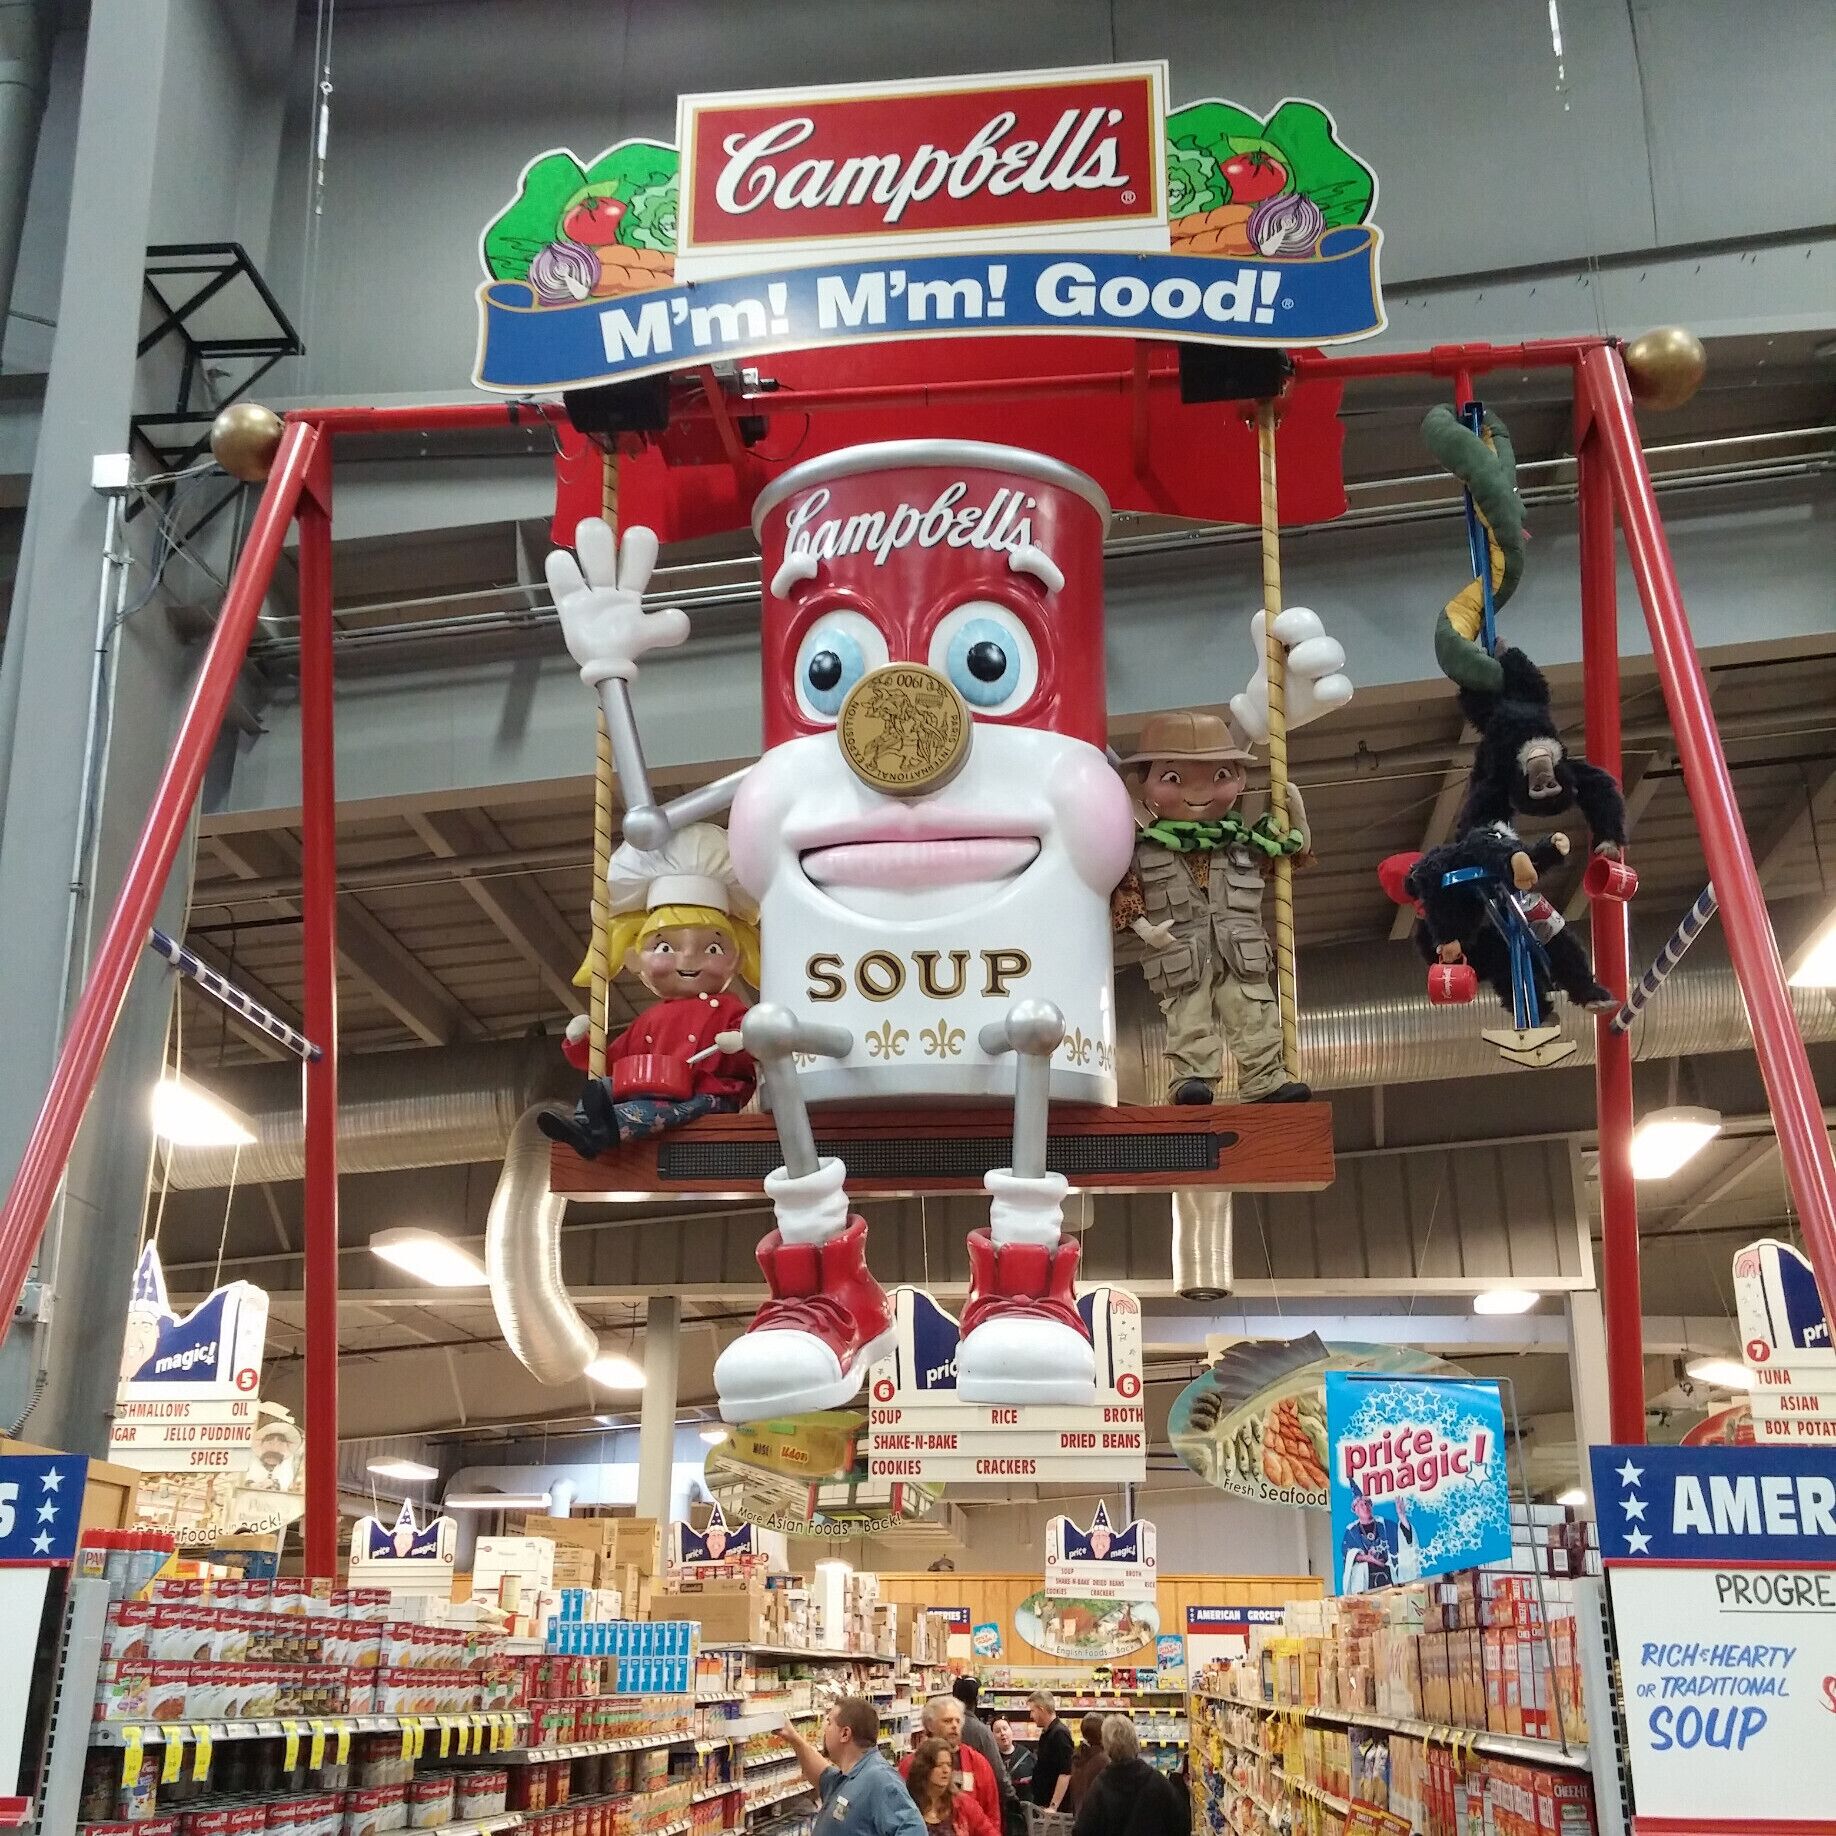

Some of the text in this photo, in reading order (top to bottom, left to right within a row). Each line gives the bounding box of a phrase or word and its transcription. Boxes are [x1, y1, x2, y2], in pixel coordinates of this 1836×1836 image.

[715, 106, 1129, 224] Campbell's
[600, 262, 1281, 363] M'm! M'm! Good!
[783, 481, 1036, 566] Campbell's
[897, 674, 923, 688] 1900
[845, 700, 959, 781] PARIS INTERNATIONAL EXPOSITION
[806, 948, 1032, 1002] SOUP
[155, 1341, 217, 1374] magic!
[1756, 1370, 1791, 1385] TUNA
[232, 1402, 248, 1416] OIL
[871, 1407, 1143, 1424] SOUP RICE BROTH
[1780, 1396, 1819, 1411] ASIAN
[164, 1427, 196, 1441] JELLO
[200, 1427, 251, 1441] PUDDING
[1765, 1420, 1791, 1435] BOX
[874, 1433, 1141, 1450] SHAKE-N-BAKE DRIED BEANS
[190, 1451, 229, 1466] SPICES
[871, 1459, 1036, 1475] COOKIES CRACKERS
[1362, 1434, 1490, 1497] magic!
[1223, 1478, 1328, 1505] Fresh Seafood
[1673, 1475, 1836, 1535] AMER
[737, 1506, 901, 1535] More Asian Foods Back!
[180, 1525, 224, 1542] Foods
[1715, 1573, 1836, 1607] PROGRE
[1196, 1609, 1241, 1621] AMERICAN
[1636, 1675, 1790, 1699] OR TRADITIONAL
[1649, 1705, 1768, 1751] SOUP
